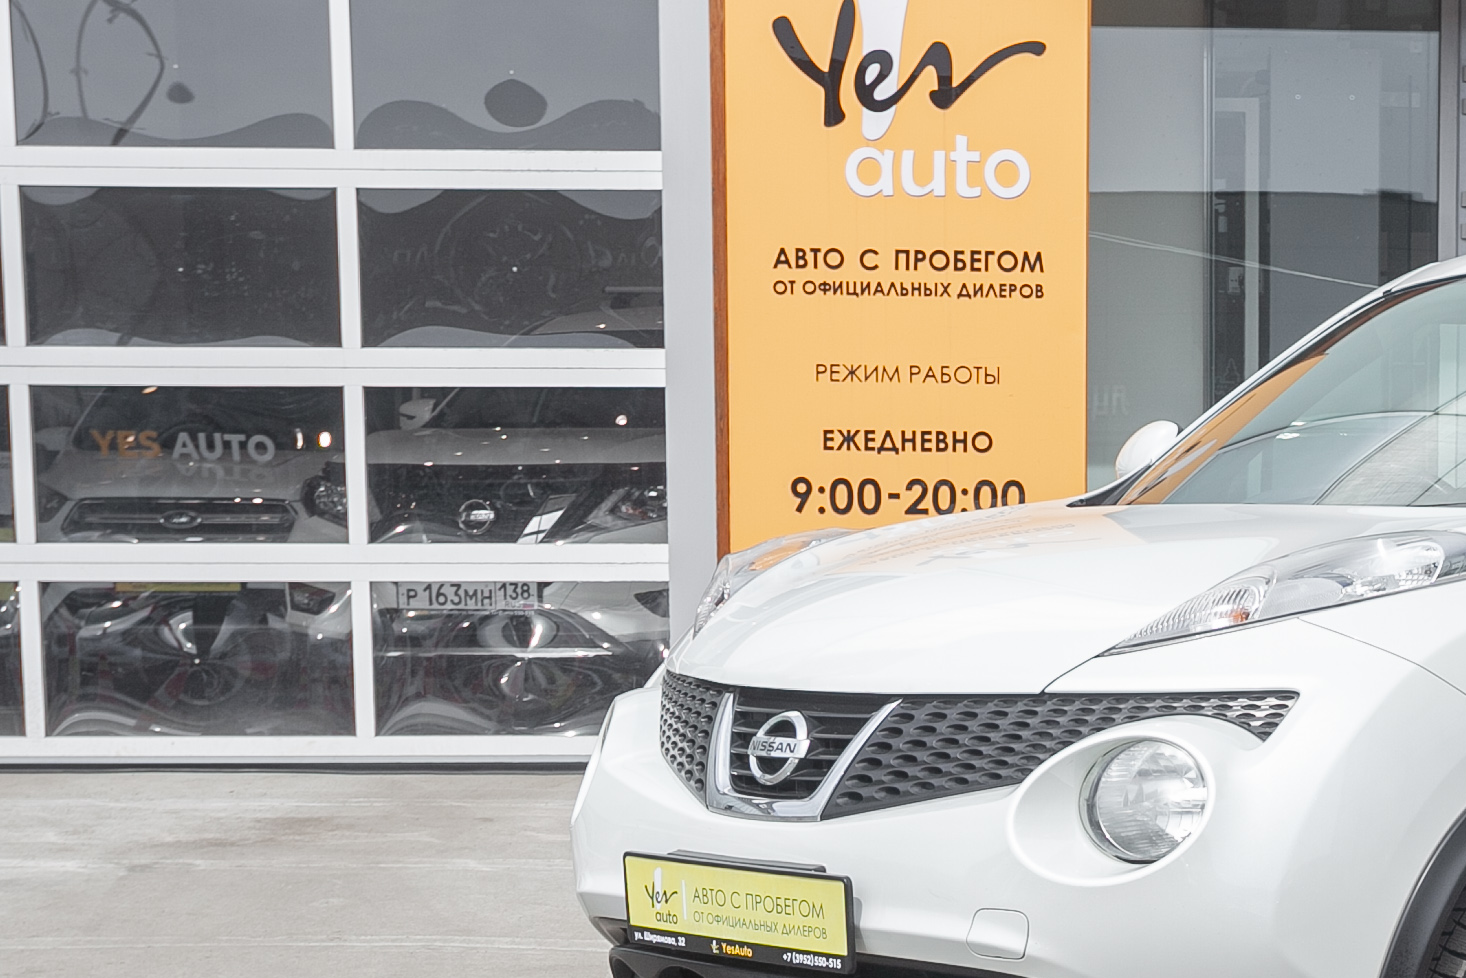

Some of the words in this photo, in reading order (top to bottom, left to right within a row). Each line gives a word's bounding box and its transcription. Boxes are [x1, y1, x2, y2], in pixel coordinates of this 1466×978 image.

[772, 0, 1046, 127] Yes
[845, 134, 1031, 199] auto
[772, 247, 845, 271] АВТО
[858, 249, 880, 271] С
[893, 249, 1045, 273] ПРОБЕГОМ
[772, 280, 797, 295] ОТ
[802, 281, 952, 299] ОФИЦИАЛЬНЫХ
[956, 283, 1045, 300] ДИЛЕРОВ
[815, 363, 901, 384] РЕЖИМ
[909, 365, 1001, 385] РАБОТЫ
[89, 430, 162, 459] YES
[171, 431, 276, 462] AUTO
[822, 429, 994, 455] ЕЖЕДНЕВНО
[790, 476, 1026, 516] 9:00-20:00
[498, 582, 531, 600] 138
[750, 740, 797, 753] NISSAN
[644, 879, 679, 909] Yes
[692, 887, 726, 908] АВТО
[730, 892, 741, 909] С
[745, 893, 825, 920] ПРОБЕГОМ
[655, 911, 679, 925] auto
[693, 910, 706, 923] ОТ
[706, 912, 779, 934] ОФИЦИАЛЬНЫХ
[781, 921, 828, 940] ДИЛЕРОВ
[721, 942, 753, 958] YesAuto
[782, 952, 792, 963] +7
